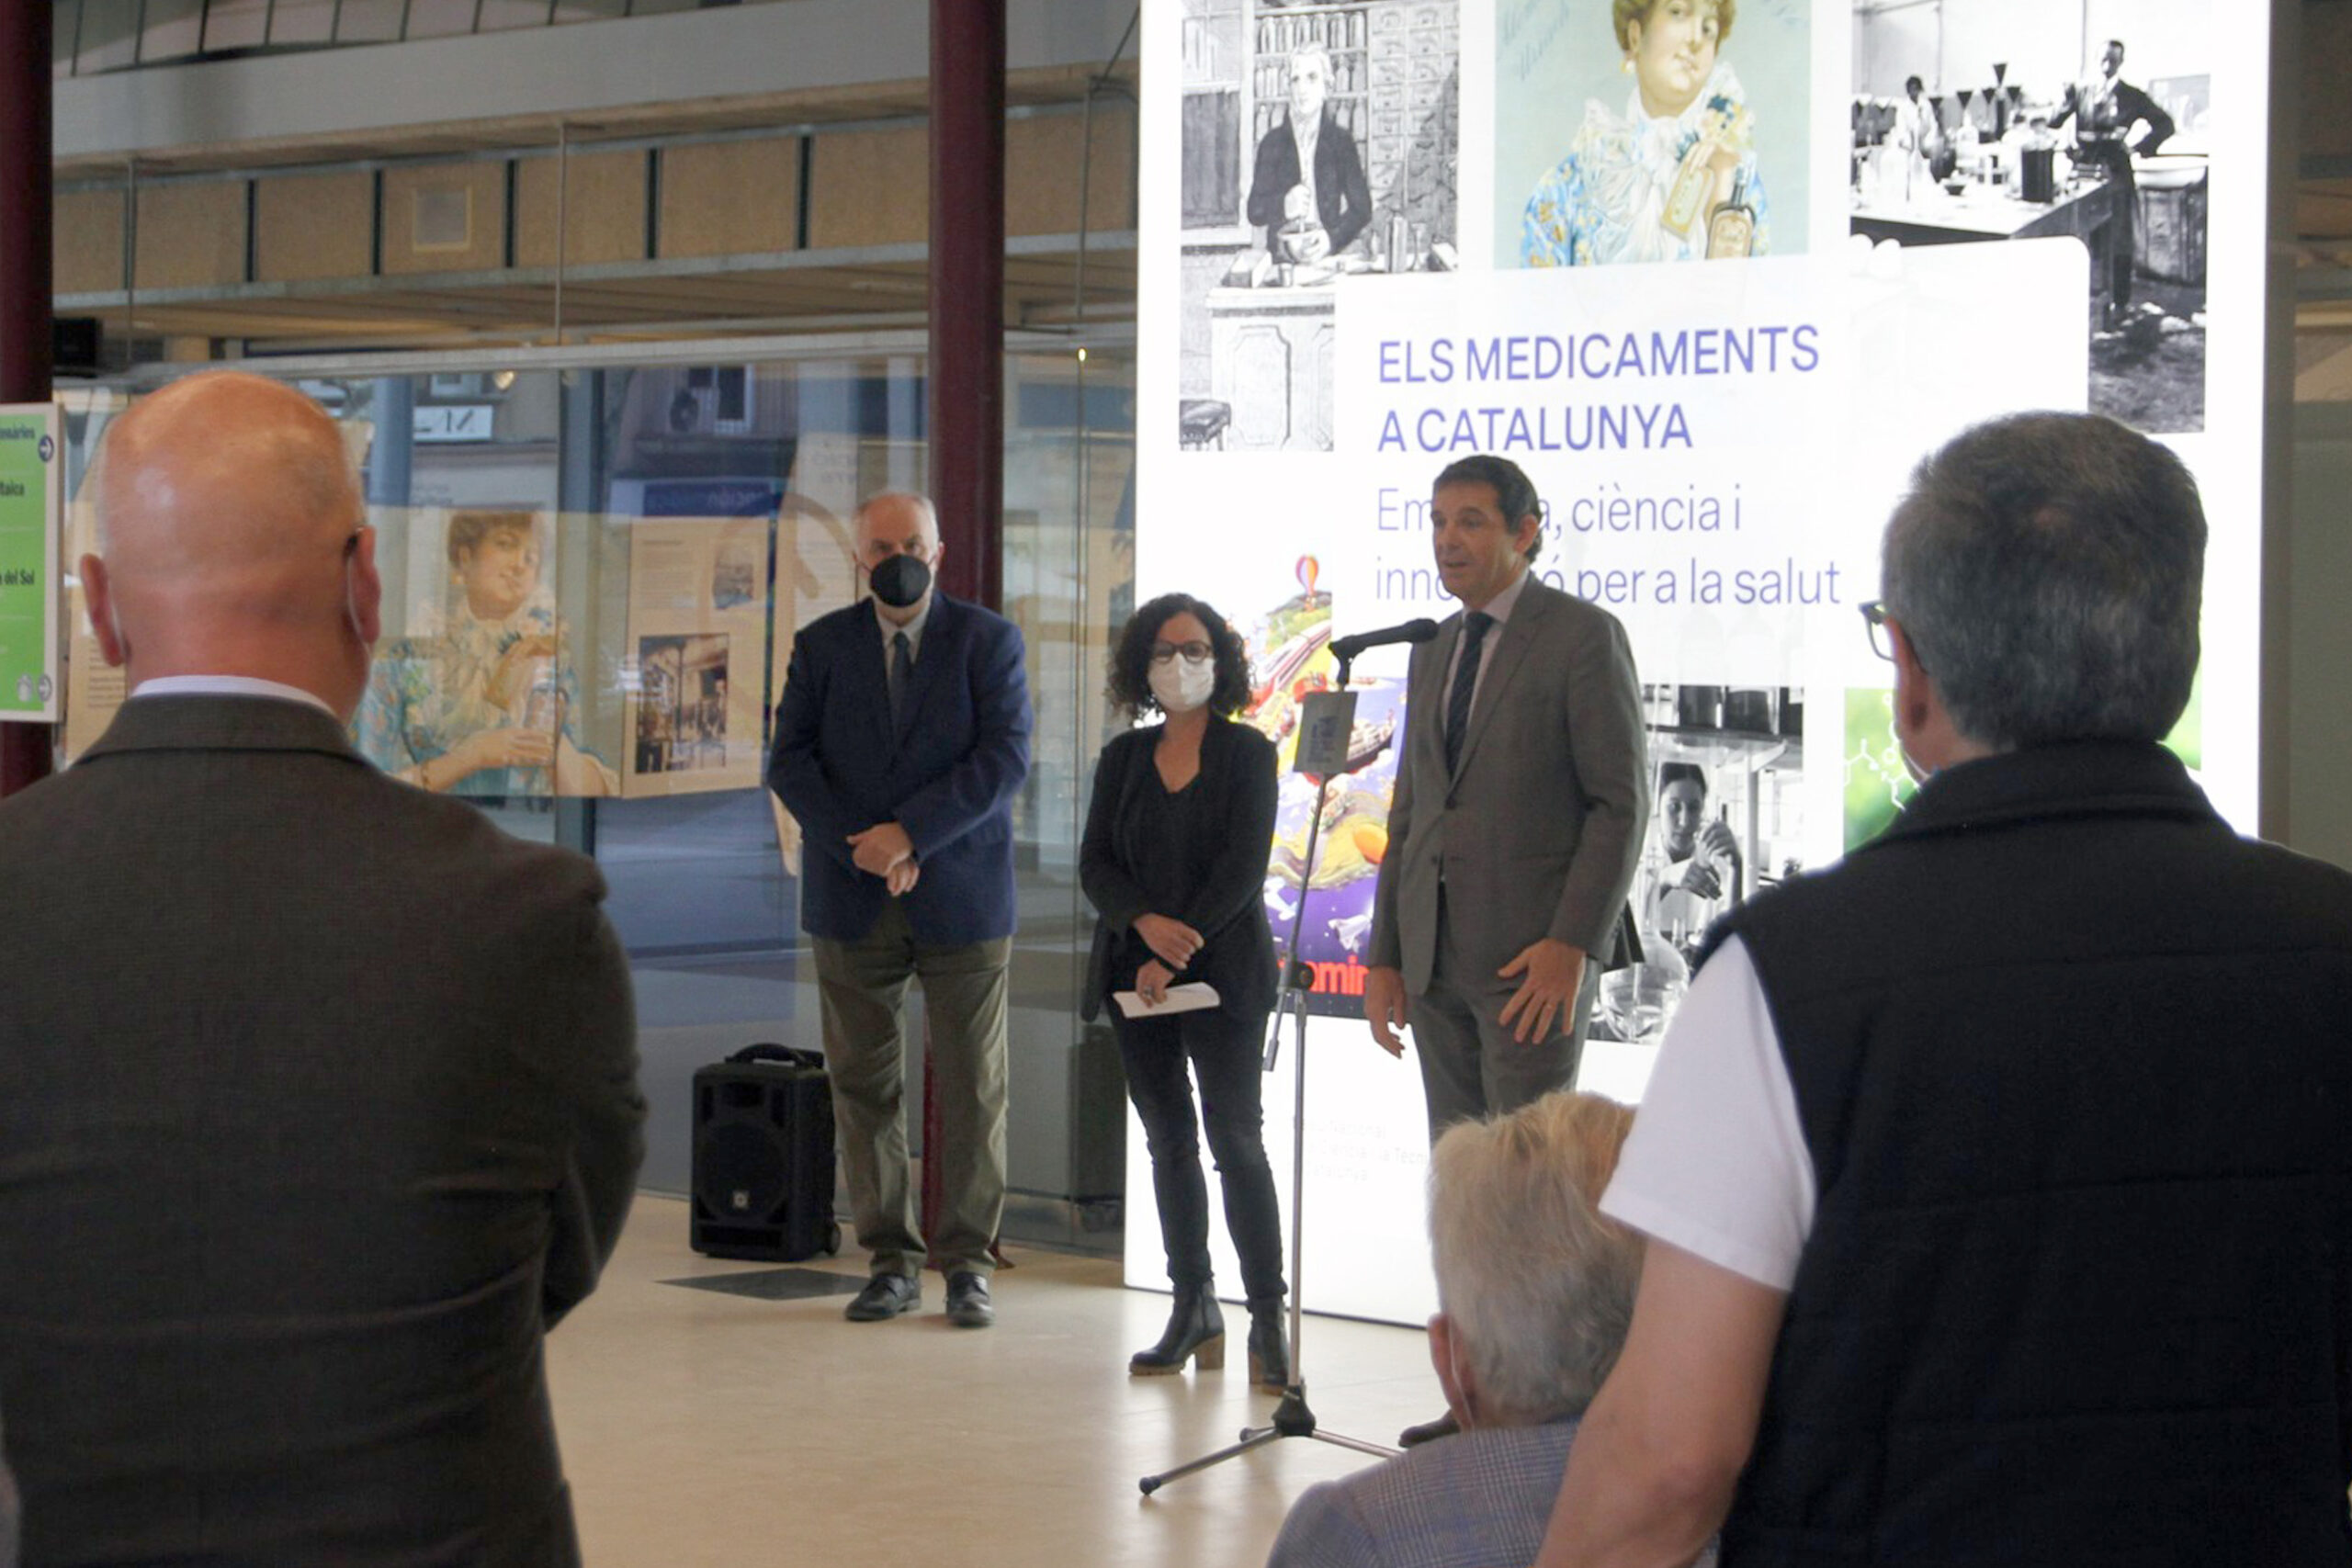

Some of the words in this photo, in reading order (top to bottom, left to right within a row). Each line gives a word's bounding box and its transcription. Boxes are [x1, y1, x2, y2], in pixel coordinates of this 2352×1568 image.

[1378, 337, 1455, 383] ELS
[1465, 324, 1820, 381] MEDICAMENTS
[1377, 410, 1407, 452] A
[1416, 403, 1693, 453] CATALUNYA
[1571, 482, 1721, 534] ciència
[1734, 483, 1742, 532] i
[1577, 568, 1646, 605] per
[1655, 570, 1678, 605] a
[1690, 557, 1724, 605] la
[1734, 557, 1842, 605] salut
